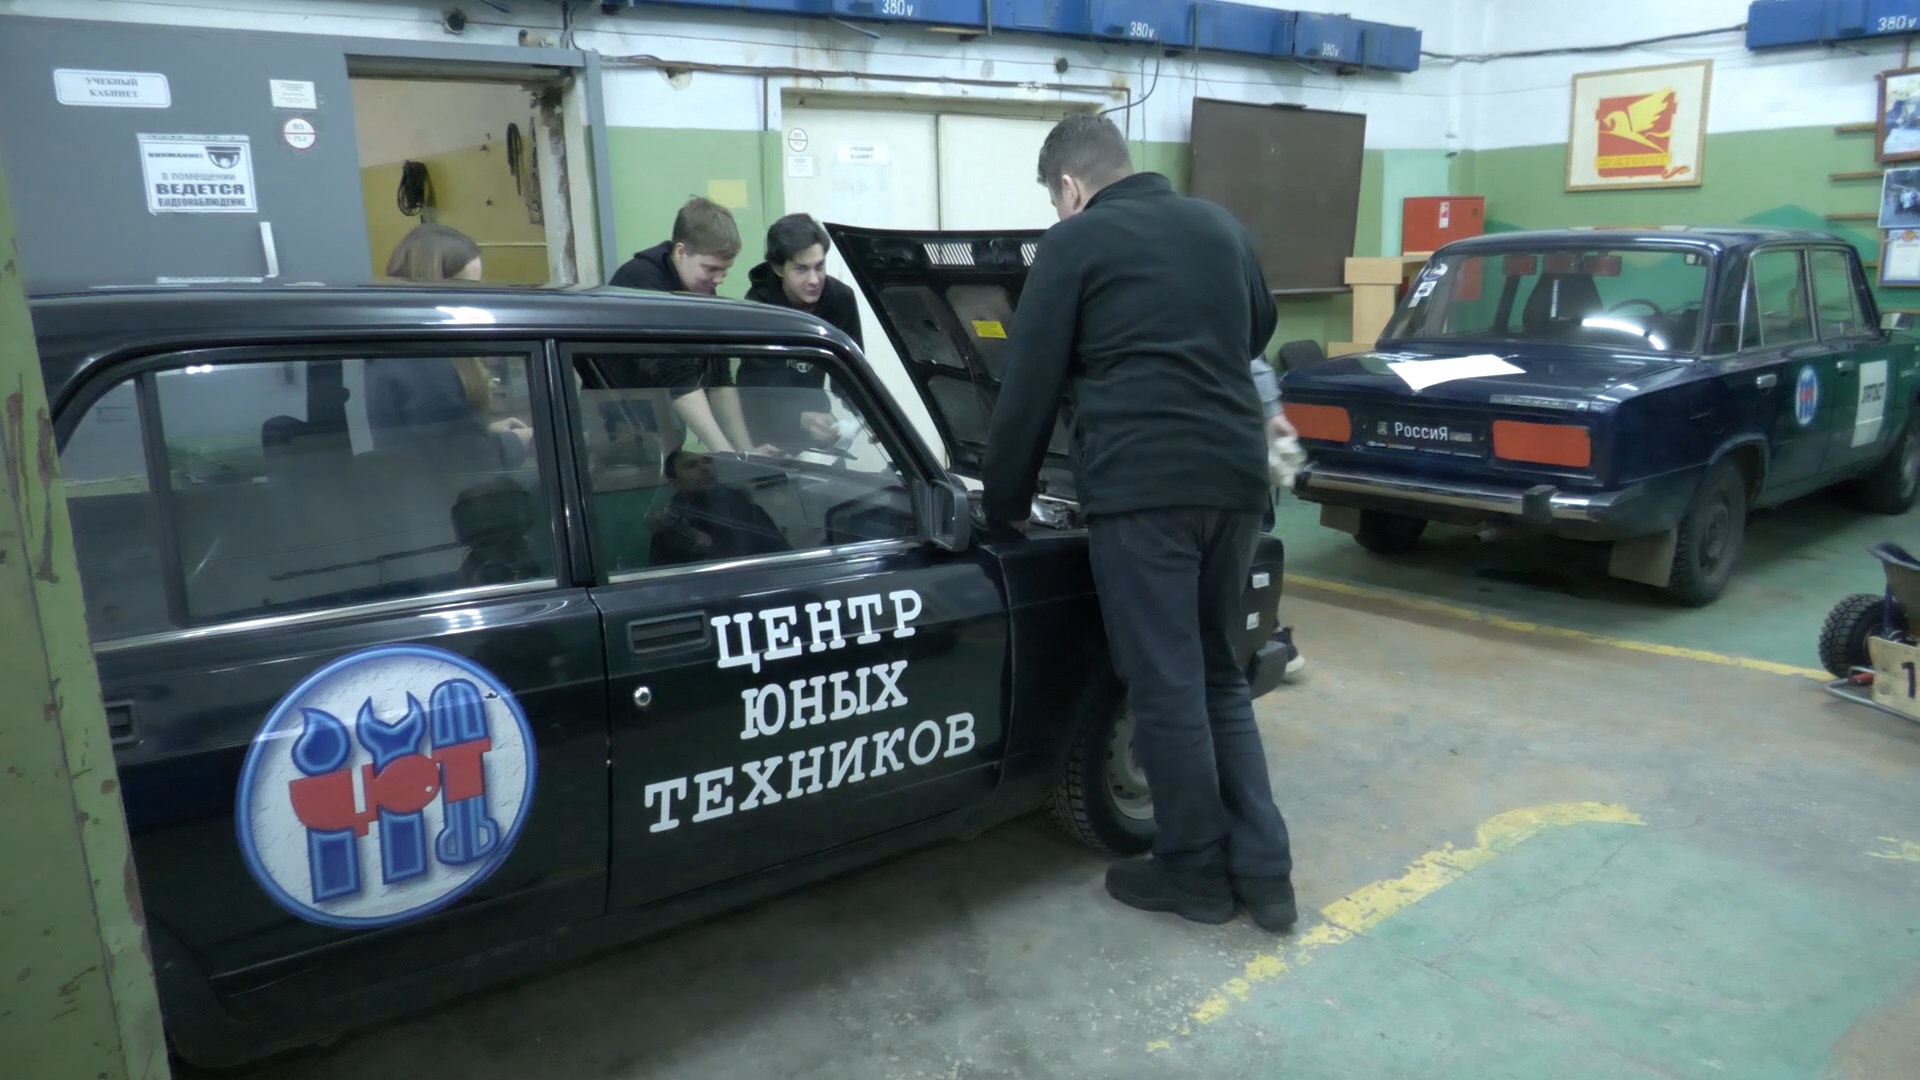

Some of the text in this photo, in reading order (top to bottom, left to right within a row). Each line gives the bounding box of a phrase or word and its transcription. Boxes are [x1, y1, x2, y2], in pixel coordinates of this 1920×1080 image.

[86, 77, 138, 87] УЧЕБНЫЙ
[89, 89, 138, 98] КАБИНЕТ
[155, 183, 246, 196] ВЕДЕТСЯ
[158, 197, 247, 208] ВИДЕОНАБЛЮДЕНИЕ
[710, 588, 923, 673] ЦЕНТР
[739, 659, 909, 741] ЮНЫХ
[643, 711, 977, 834] ТЕХНИКОВ
